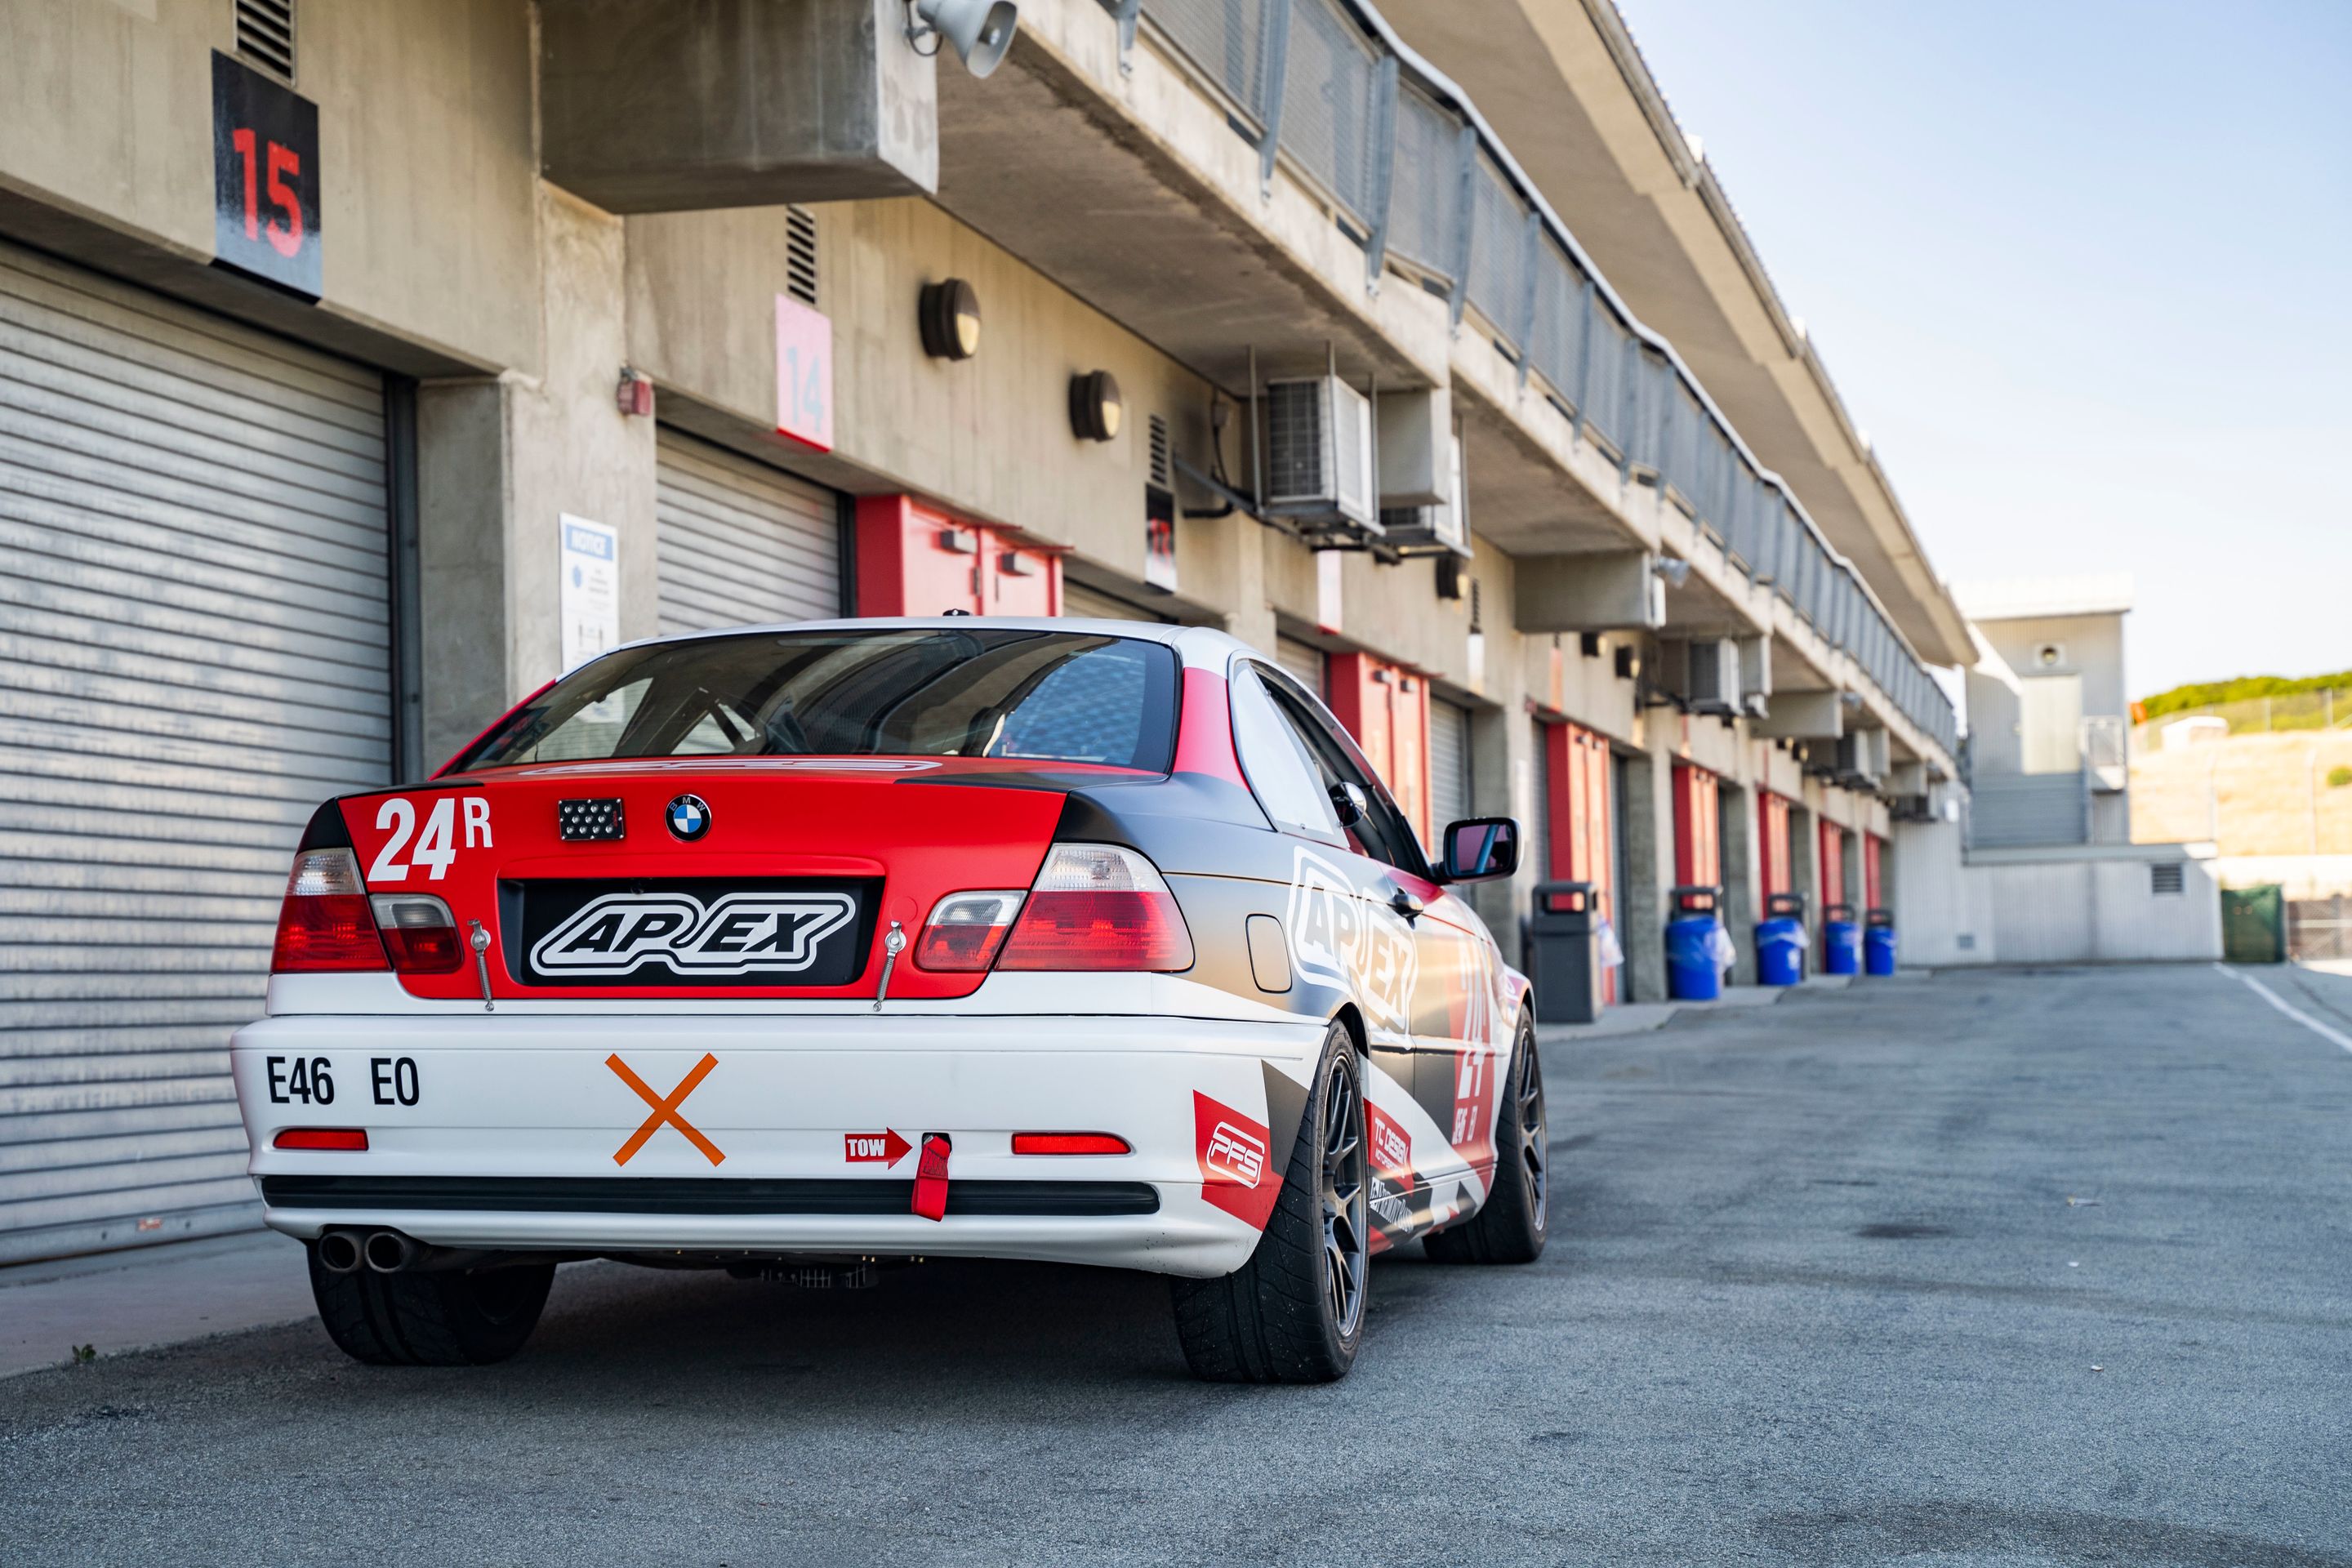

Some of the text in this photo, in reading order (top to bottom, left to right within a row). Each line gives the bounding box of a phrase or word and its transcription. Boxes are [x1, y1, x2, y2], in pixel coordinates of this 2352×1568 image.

[232, 127, 304, 259] 15
[786, 346, 824, 434] 14
[669, 796, 706, 812] BMW
[557, 912, 826, 954] APEX
[1303, 880, 1408, 1018] APEX
[266, 1055, 335, 1106] E46
[847, 1138, 886, 1157] TOW
[1209, 1131, 1264, 1178] PFS
[1374, 1116, 1386, 1147] TC
